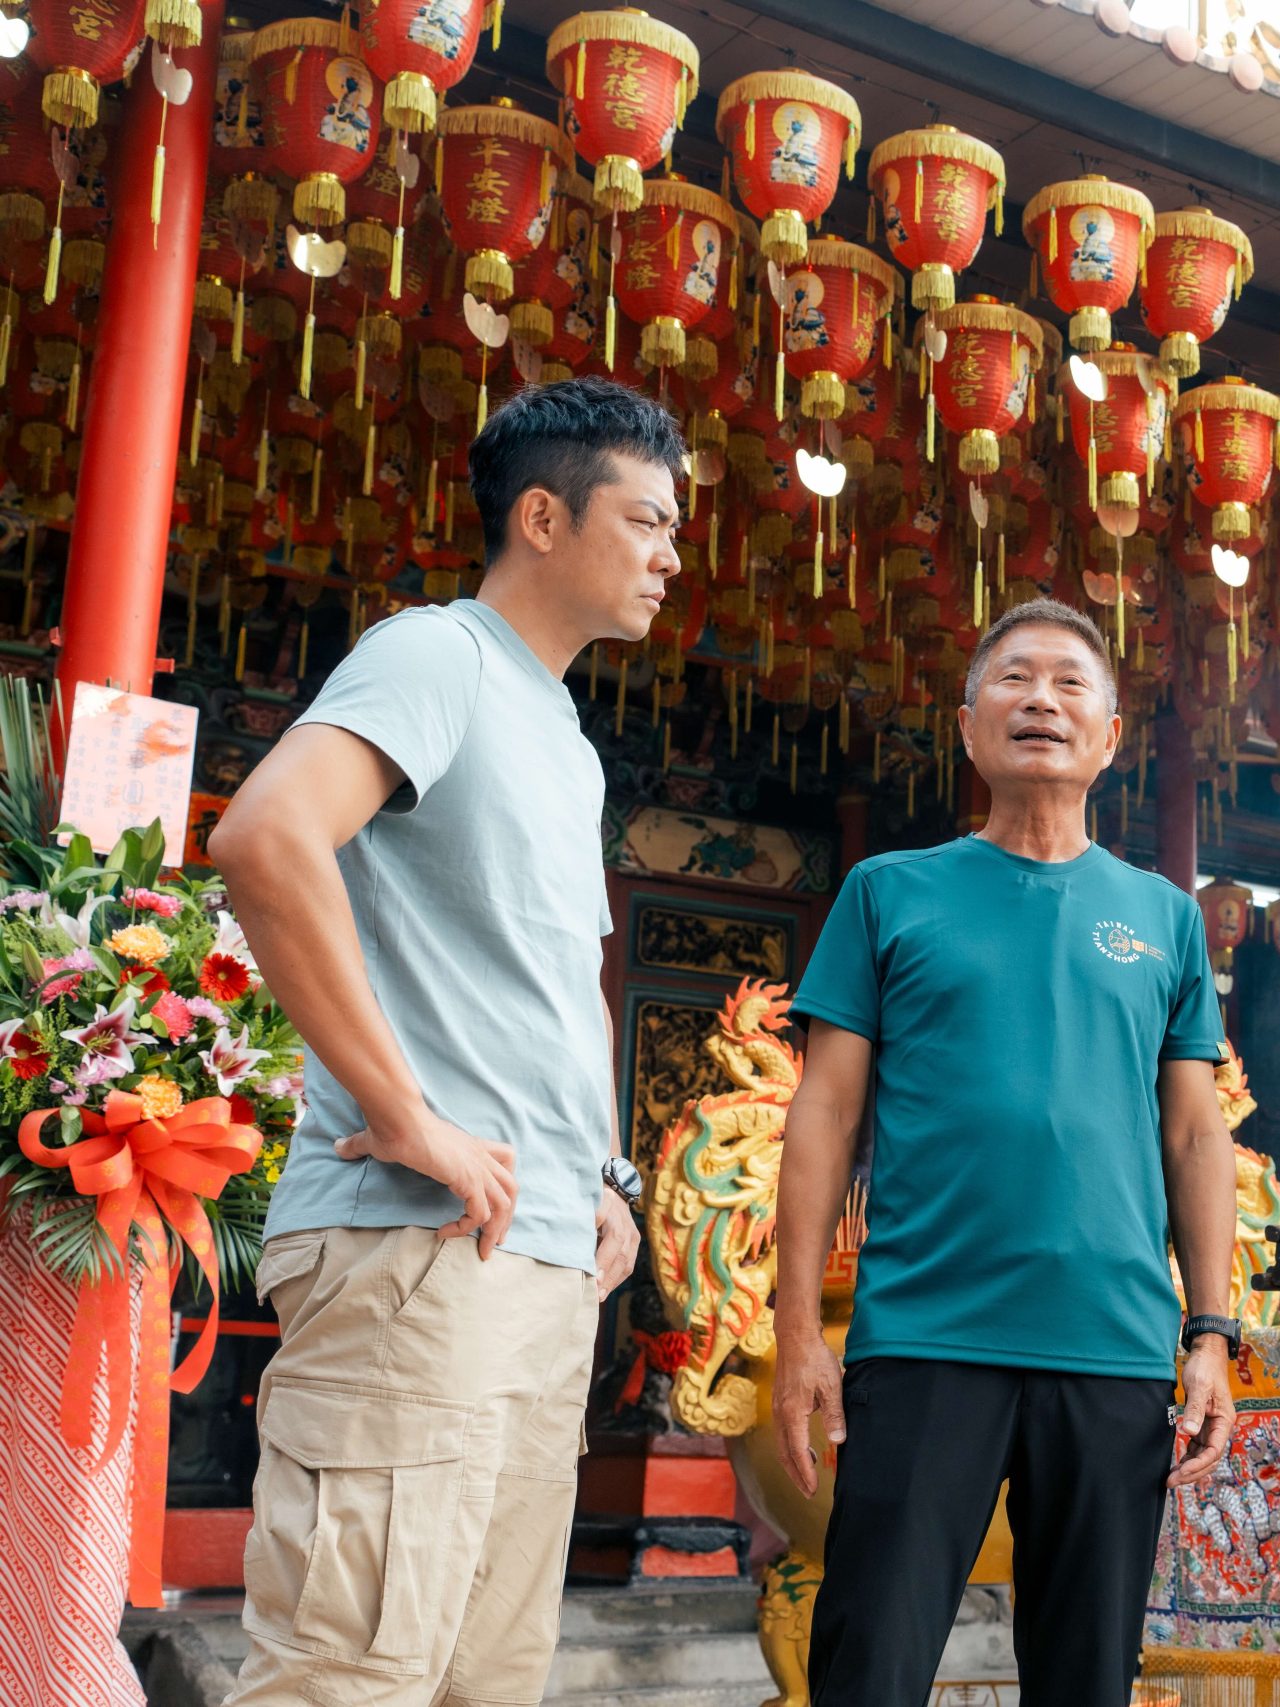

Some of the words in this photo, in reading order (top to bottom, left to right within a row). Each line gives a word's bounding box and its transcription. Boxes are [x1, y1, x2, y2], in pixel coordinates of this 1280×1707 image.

[605, 46, 648, 130] 乾德宮
[466, 137, 511, 224] 平安燈
[933, 163, 970, 242] 乾德宮
[625, 213, 661, 290] 平安燈
[1166, 238, 1203, 308] 乾德宮
[950, 332, 986, 408] 乾德宮
[1219, 412, 1255, 483] 平安燈
[1092, 931, 1140, 964] TIANZHONG
[1096, 921, 1135, 936] TAINAN
